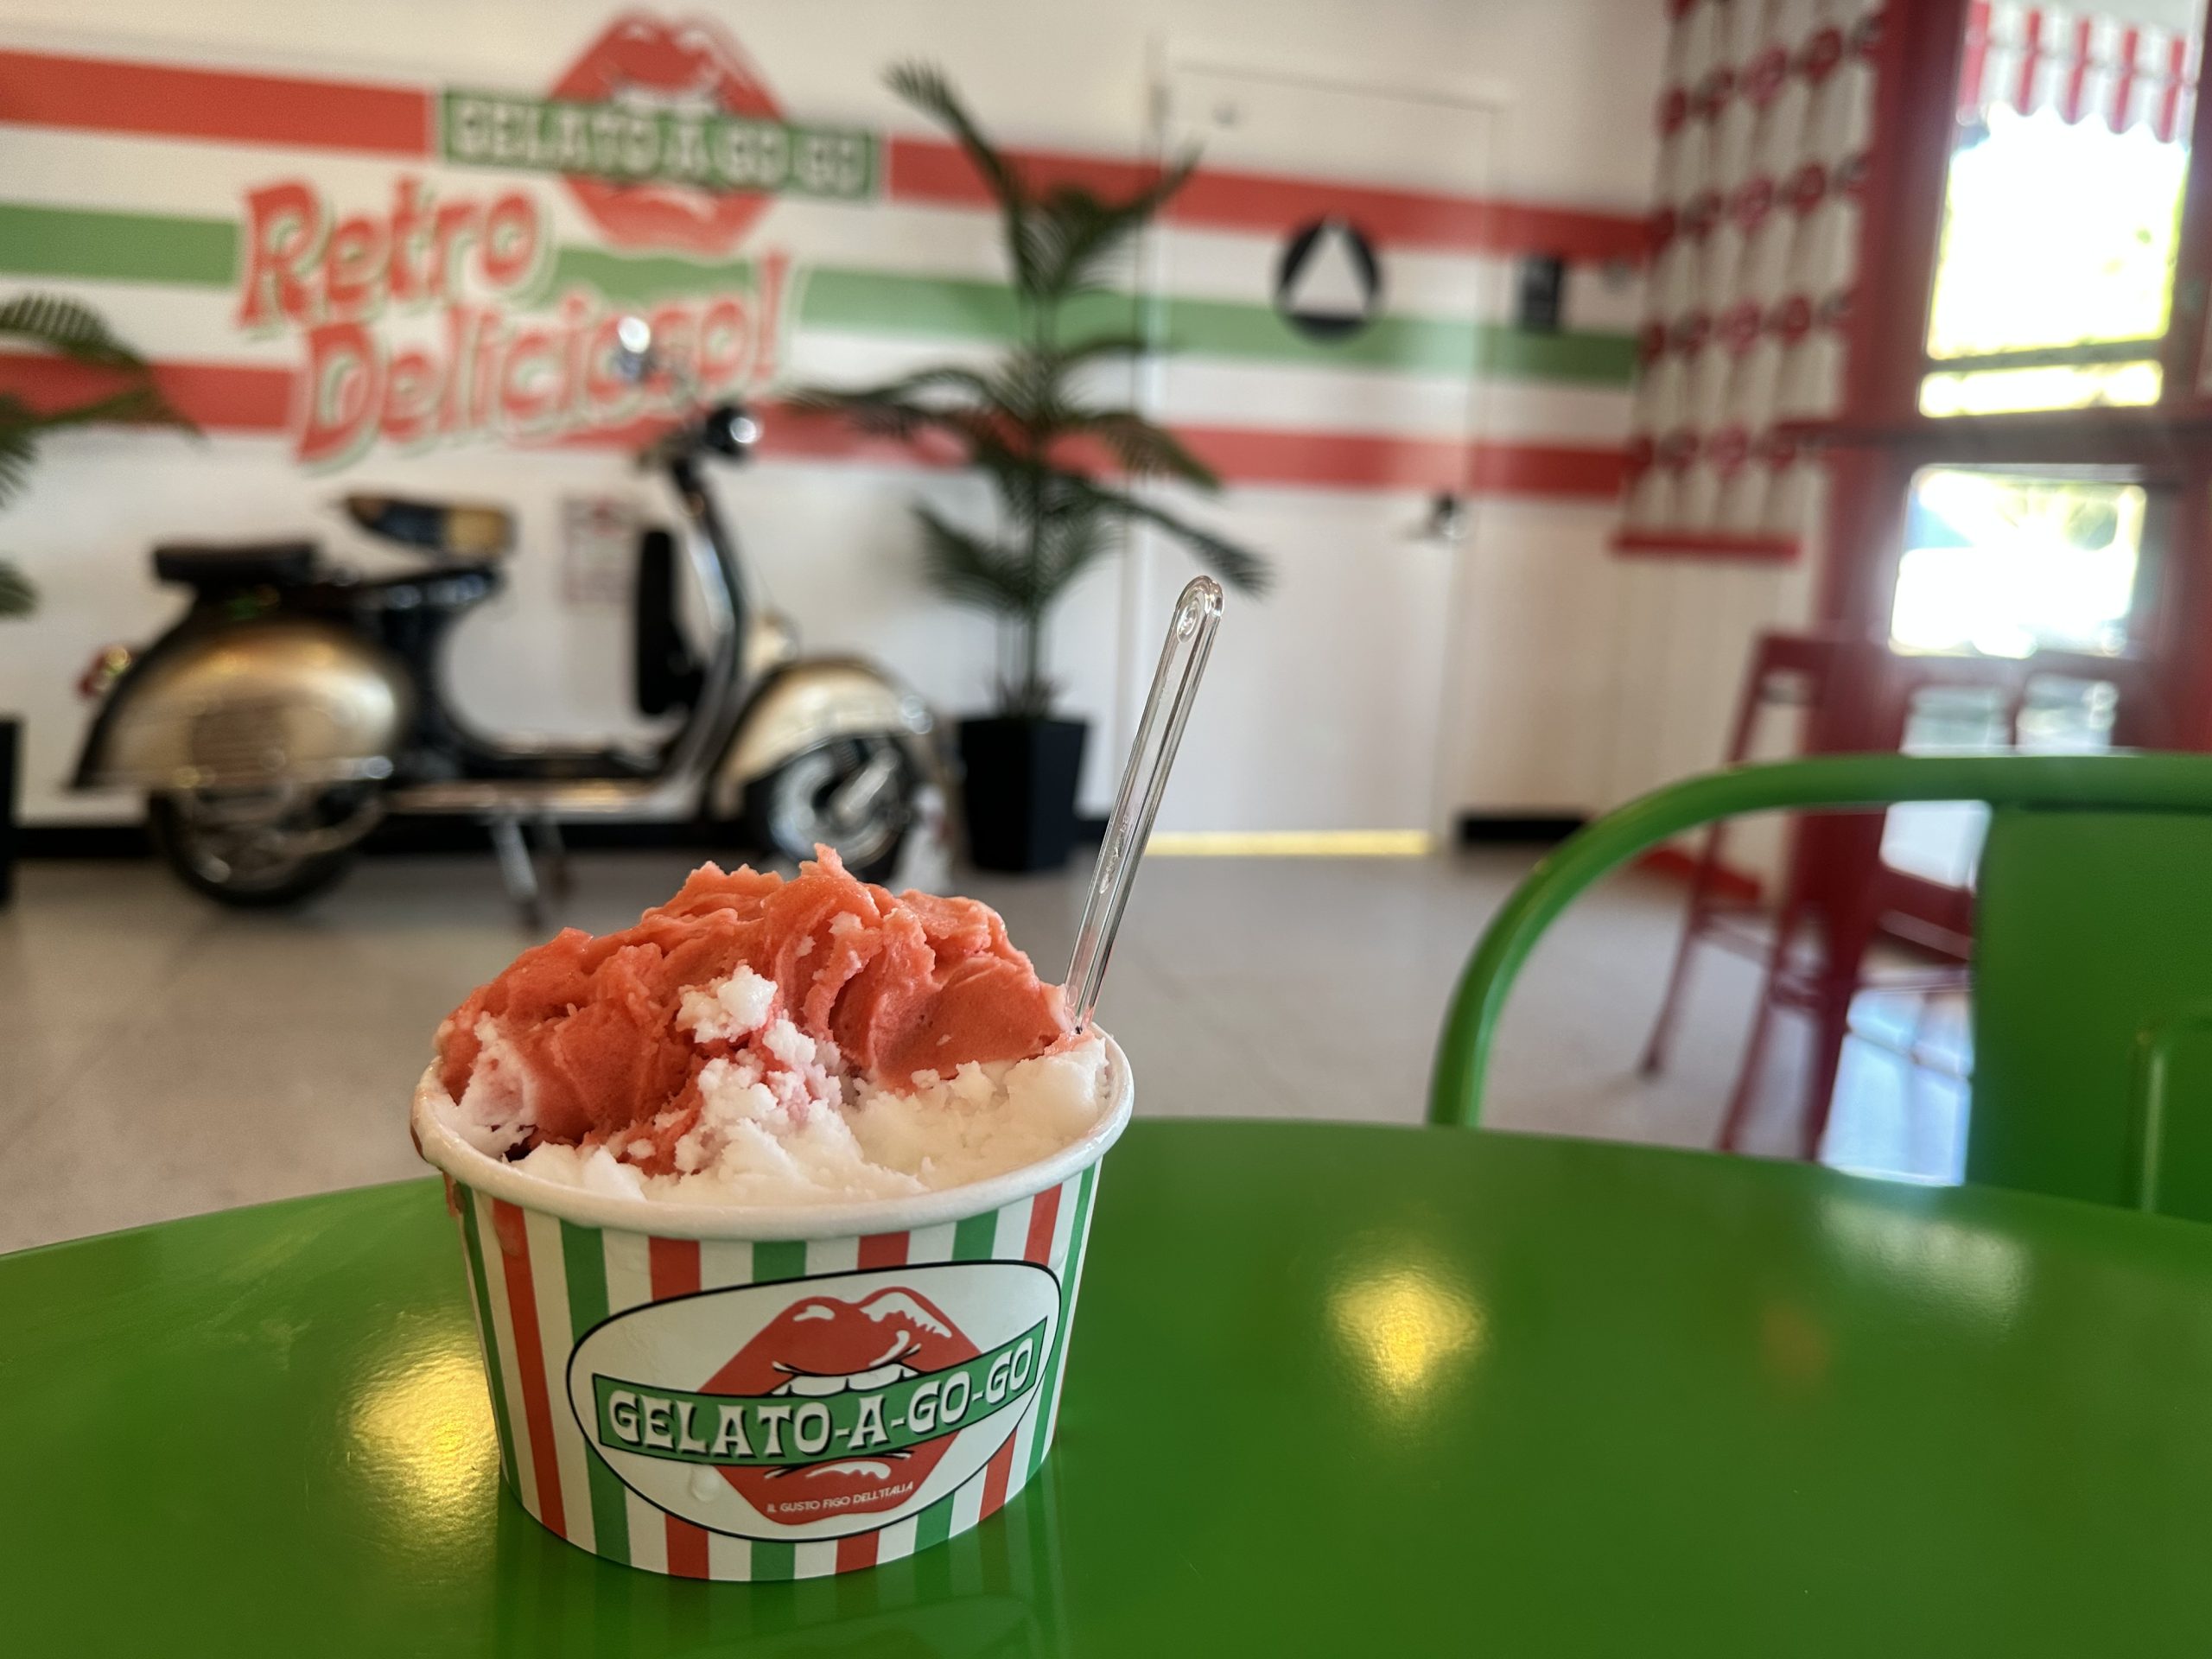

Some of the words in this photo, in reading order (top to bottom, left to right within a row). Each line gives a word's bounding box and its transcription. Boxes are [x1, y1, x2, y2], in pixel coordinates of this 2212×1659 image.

[235, 176, 548, 334] Retro
[608, 1336, 1033, 1457] GELATO-A-GO-GO
[766, 1503, 777, 1514] IL
[779, 1500, 821, 1512] GUSTO
[823, 1496, 851, 1509] FIGO
